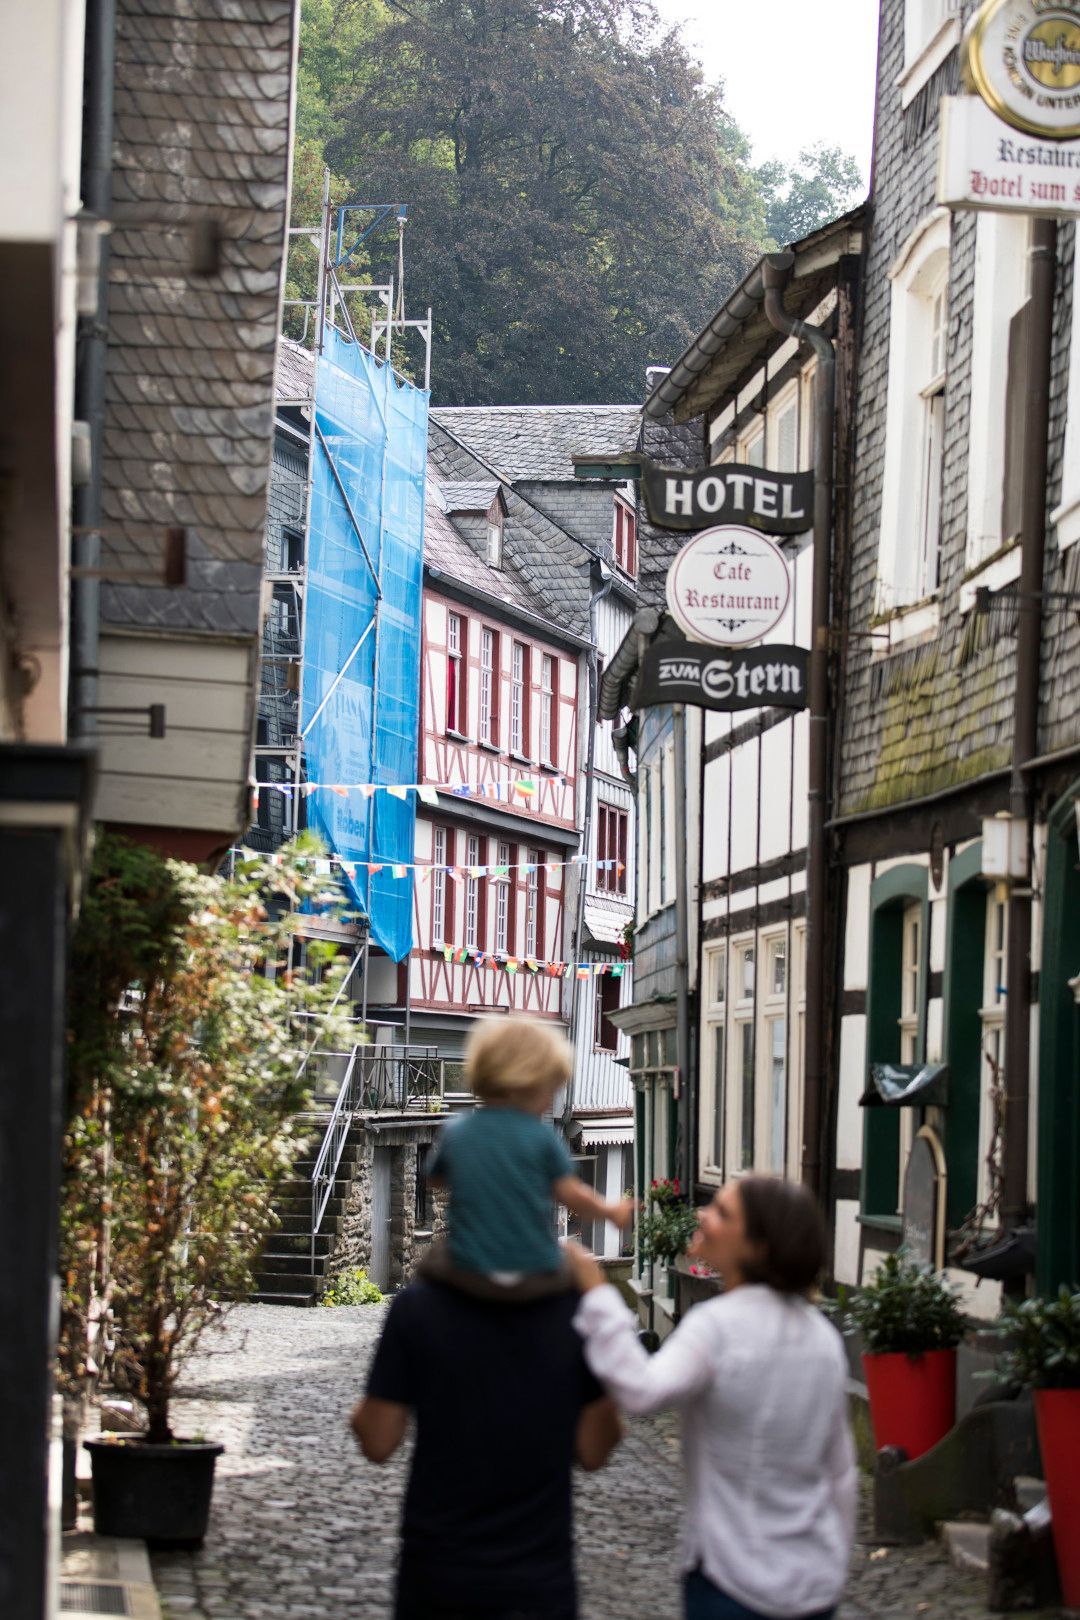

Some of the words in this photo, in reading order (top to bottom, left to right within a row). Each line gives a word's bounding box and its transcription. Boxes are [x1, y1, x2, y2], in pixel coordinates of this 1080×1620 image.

[969, 168, 1022, 196] Hotel
[1030, 181, 1066, 201] zum
[665, 474, 805, 519] HOTEL
[713, 562, 752, 581] Cafe
[685, 588, 780, 610] Restaurant
[702, 659, 802, 699] Stern
